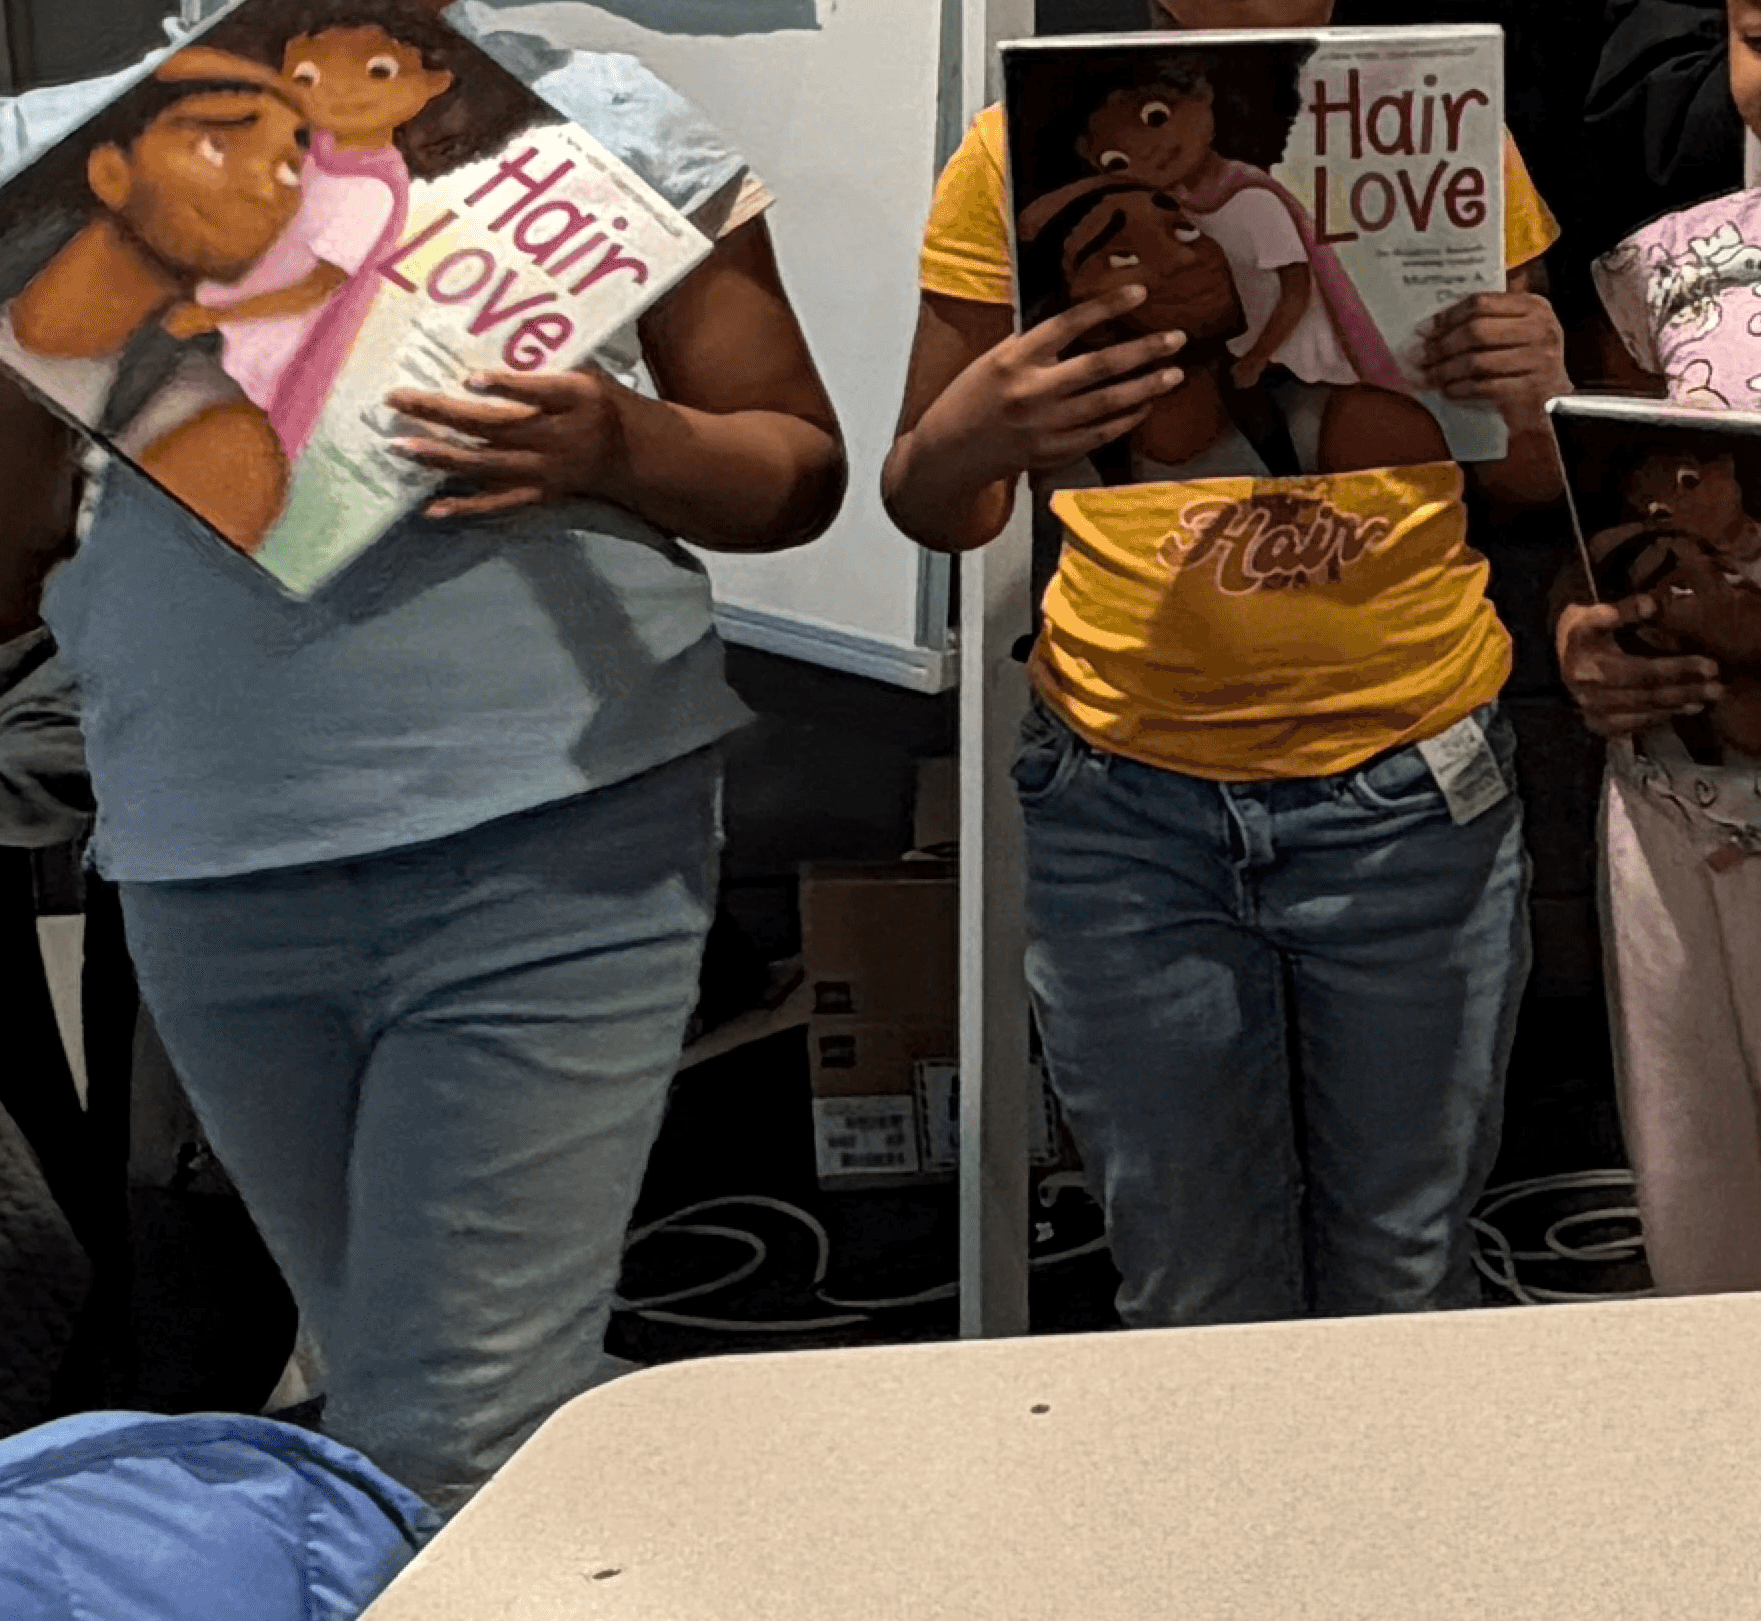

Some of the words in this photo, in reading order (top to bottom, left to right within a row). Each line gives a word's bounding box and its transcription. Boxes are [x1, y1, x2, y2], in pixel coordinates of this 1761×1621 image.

[1308, 67, 1490, 160] Hair
[463, 146, 650, 296] Hair
[1313, 158, 1488, 245] Love
[375, 208, 575, 372] Love
